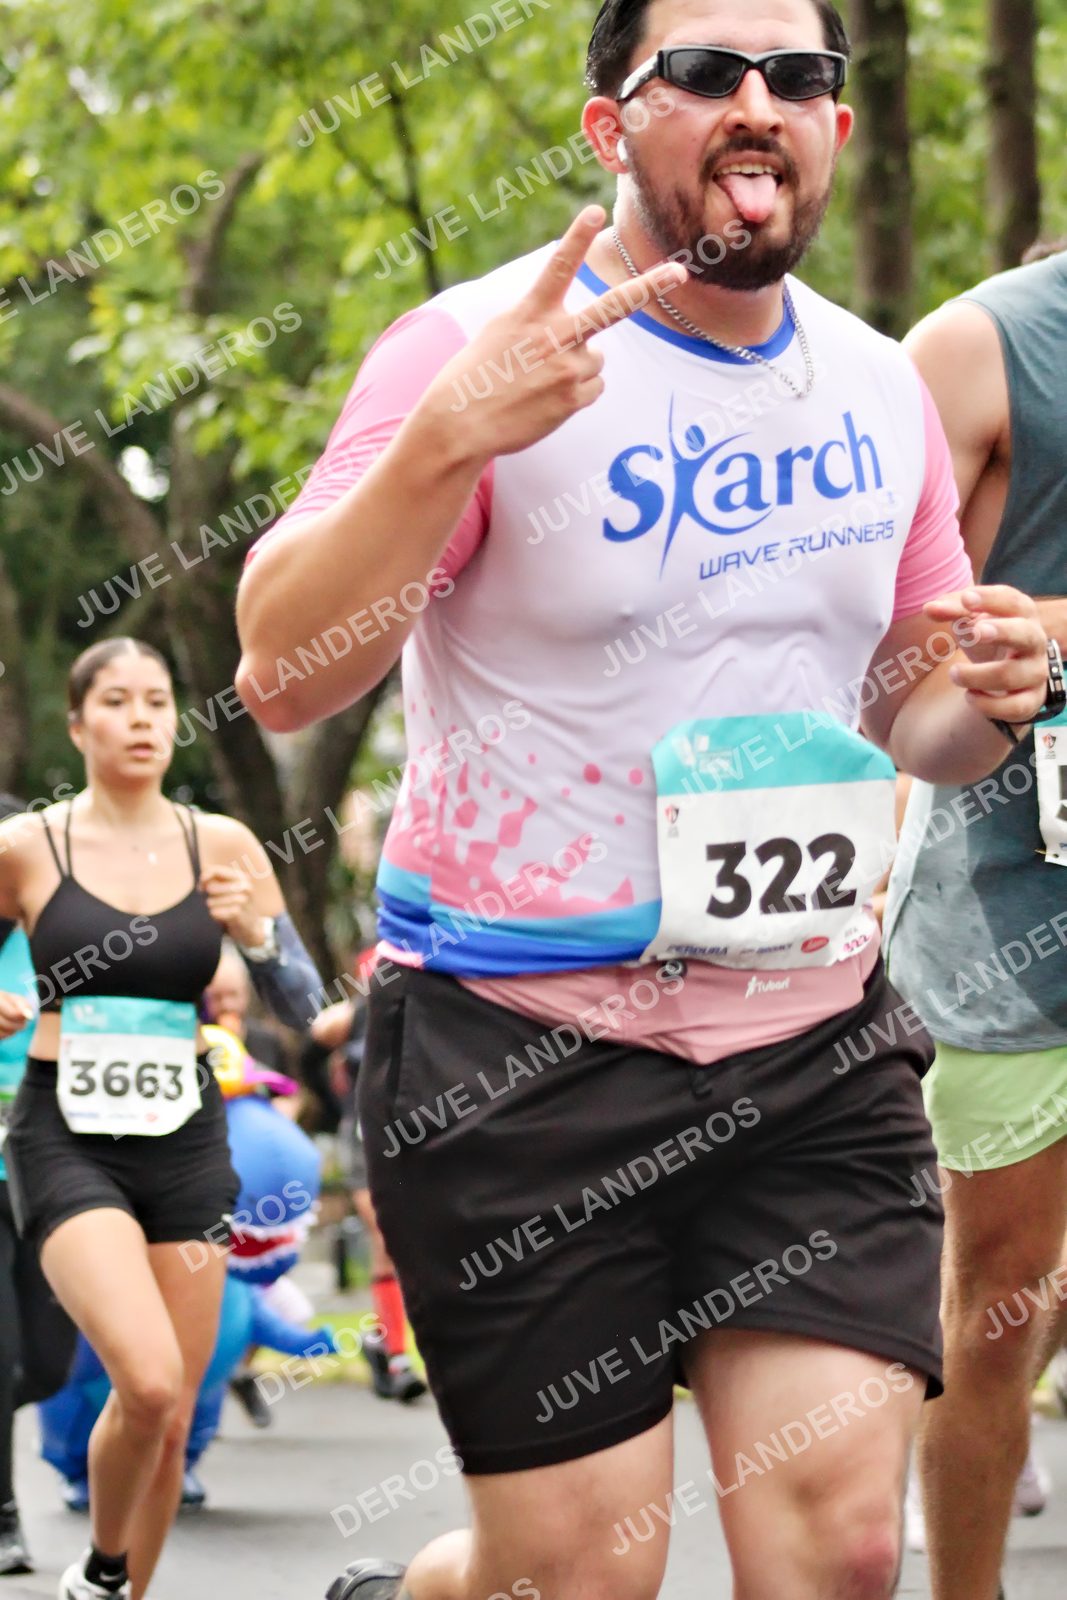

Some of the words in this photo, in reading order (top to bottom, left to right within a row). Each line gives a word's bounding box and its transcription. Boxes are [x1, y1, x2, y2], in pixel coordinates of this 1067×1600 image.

[700, 543, 781, 580] WAVE
[788, 520, 894, 557] RUNNERS
[706, 833, 857, 919] 322
[70, 1060, 183, 1101] 3663
